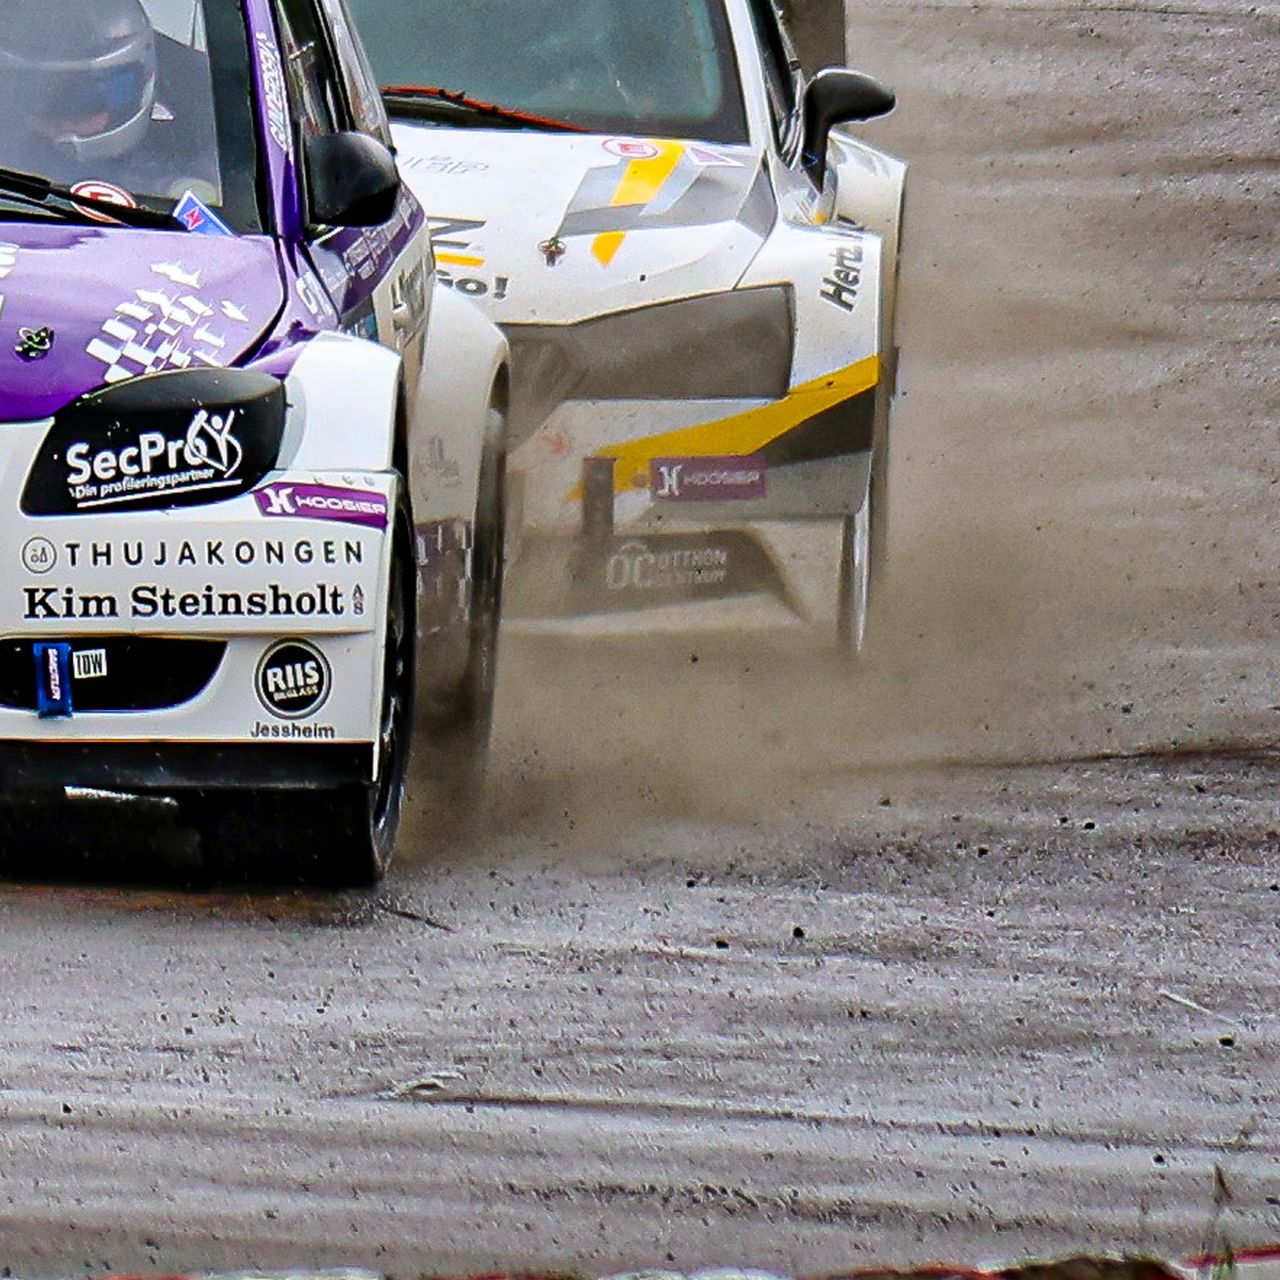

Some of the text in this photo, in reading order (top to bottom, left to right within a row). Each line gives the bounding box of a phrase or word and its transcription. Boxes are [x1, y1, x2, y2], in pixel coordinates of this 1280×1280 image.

[65, 431, 209, 486] SecPro
[295, 493, 387, 515] HOOSIER
[65, 540, 364, 567] THUJAKONGEN
[22, 587, 119, 619] Kim
[130, 583, 345, 618] Steinsholt
[75, 652, 103, 676] TOW
[266, 661, 321, 693] RIIS
[251, 721, 336, 740] Jessheim
